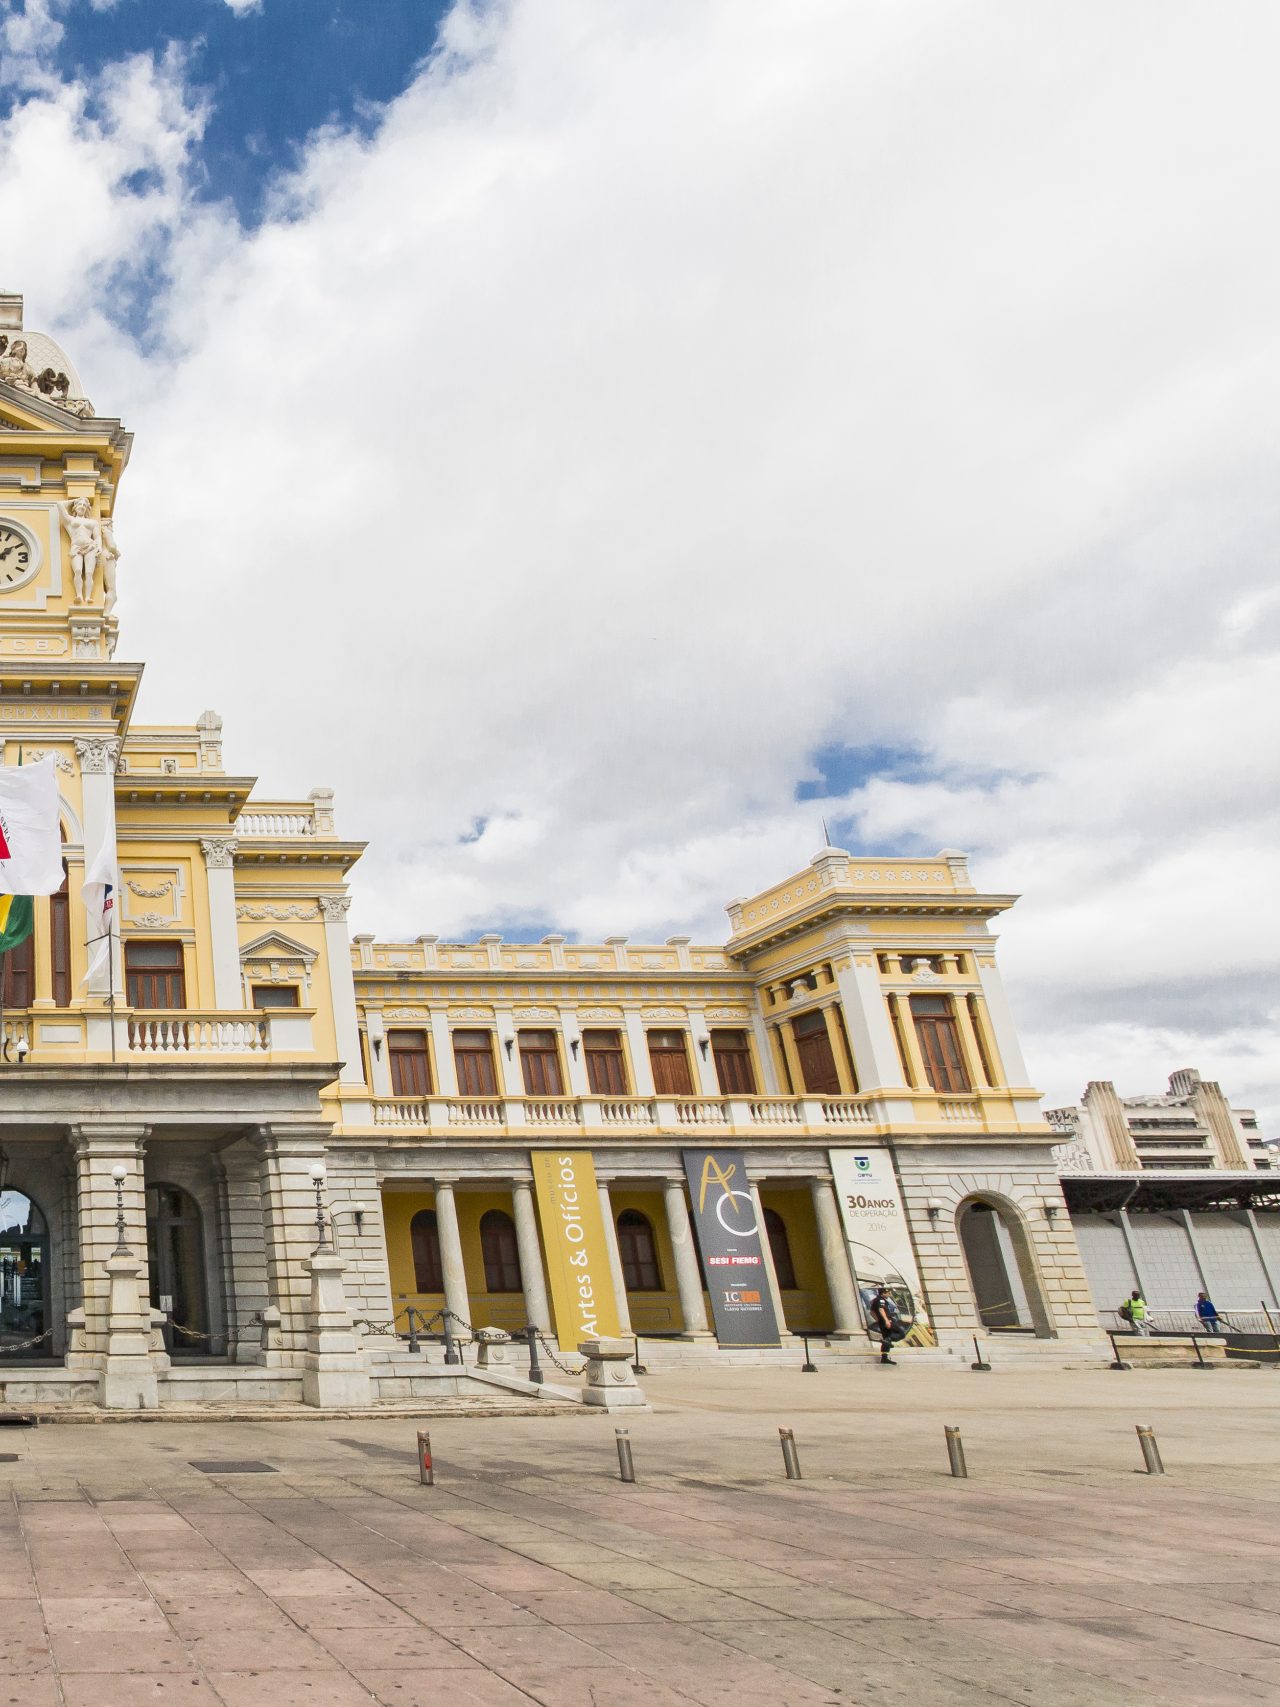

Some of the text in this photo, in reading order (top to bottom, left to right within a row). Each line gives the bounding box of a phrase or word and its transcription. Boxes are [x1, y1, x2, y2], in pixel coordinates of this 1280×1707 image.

[18, 552, 29, 563] 3
[846, 1195, 896, 1209] 30 ANOS
[860, 1208, 898, 1217] OPERAÇÃO
[867, 1222, 887, 1231] 2016
[558, 1156, 600, 1337] Artes & Ofícios
[709, 1256, 759, 1265] SESI FIEMG
